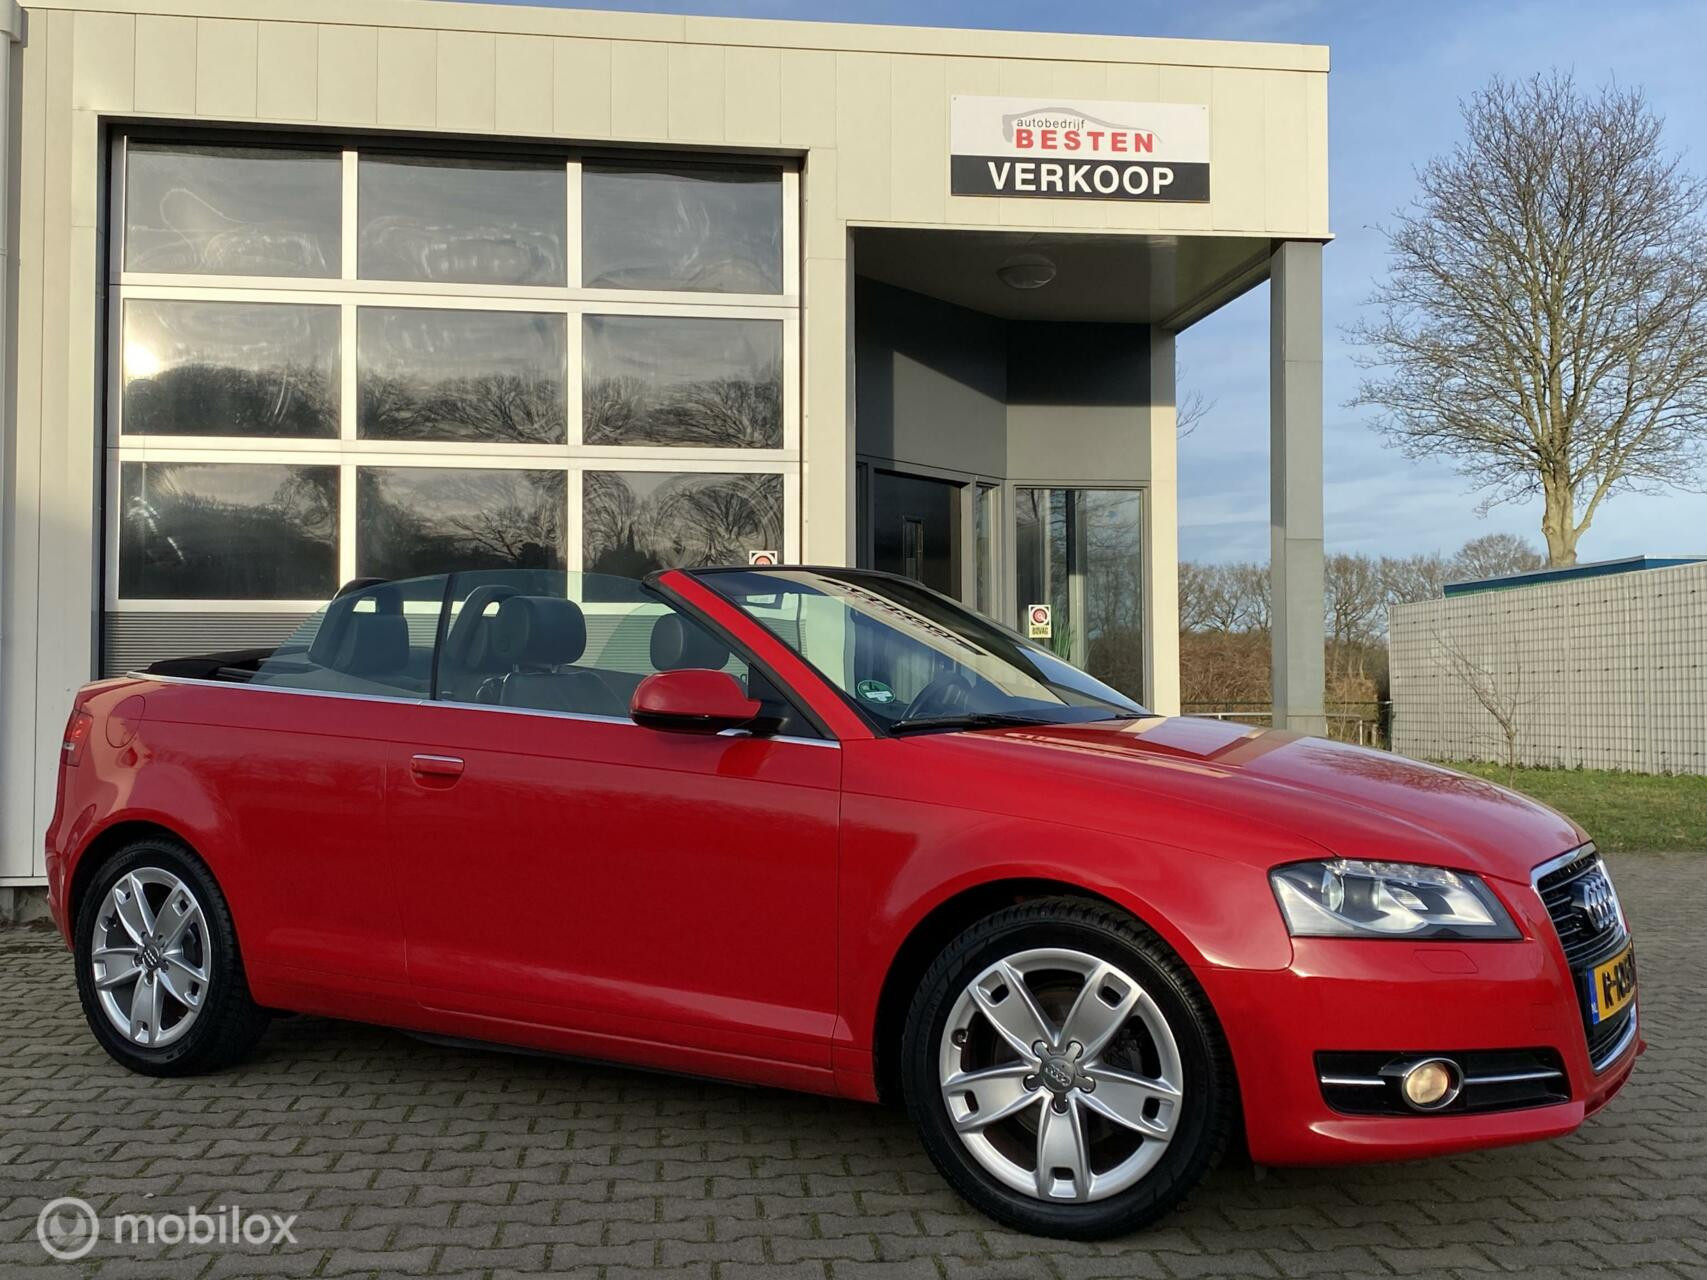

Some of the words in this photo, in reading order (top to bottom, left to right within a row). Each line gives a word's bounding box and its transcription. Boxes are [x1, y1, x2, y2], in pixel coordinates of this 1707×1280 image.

[1016, 118, 1086, 131] autobedrijf
[1015, 129, 1153, 152] BESTEN
[987, 161, 1175, 195] VERKOOP
